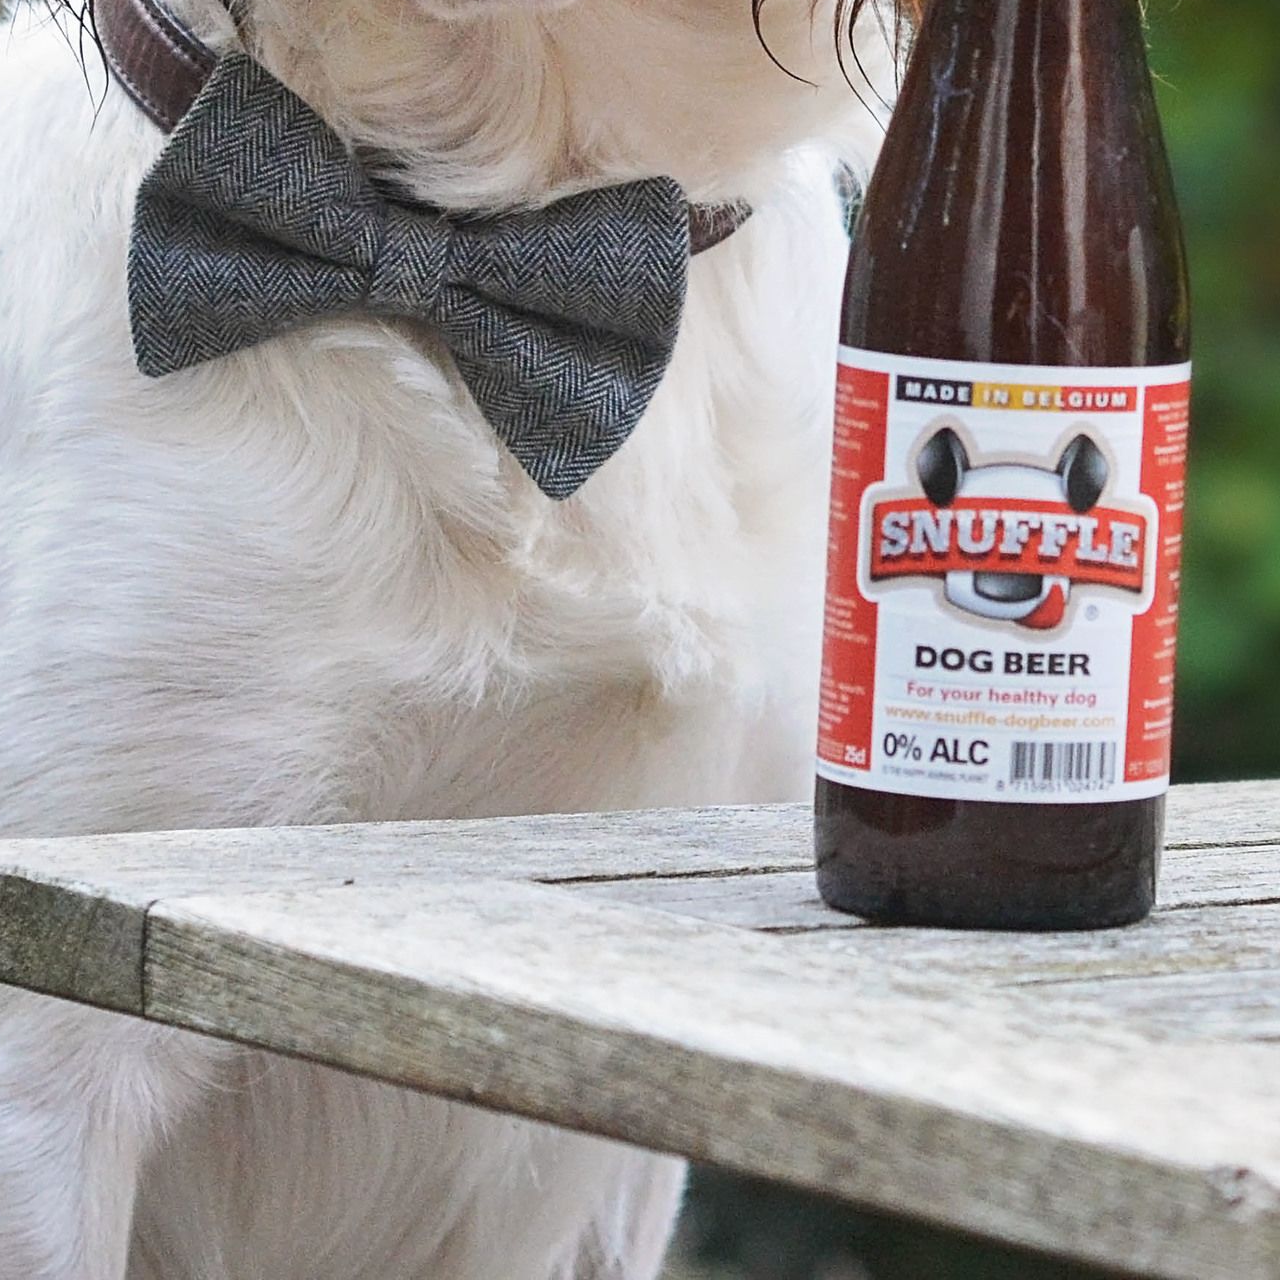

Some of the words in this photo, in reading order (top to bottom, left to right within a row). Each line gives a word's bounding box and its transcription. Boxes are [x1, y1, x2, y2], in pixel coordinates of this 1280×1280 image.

[904, 381, 970, 402] MADE
[982, 388, 1009, 405] IN
[1022, 390, 1128, 408] BELGIUM
[880, 508, 1140, 570] SNUFFLE
[915, 645, 993, 673] DOG
[1004, 652, 1091, 676] BEER
[906, 680, 934, 698] For
[940, 687, 982, 702] your
[988, 688, 1058, 707] healthy
[1064, 691, 1097, 708] dog
[884, 705, 1116, 731] www.snuffle-dogbeer.com
[883, 732, 922, 761] 0%
[930, 738, 989, 765] ALC
